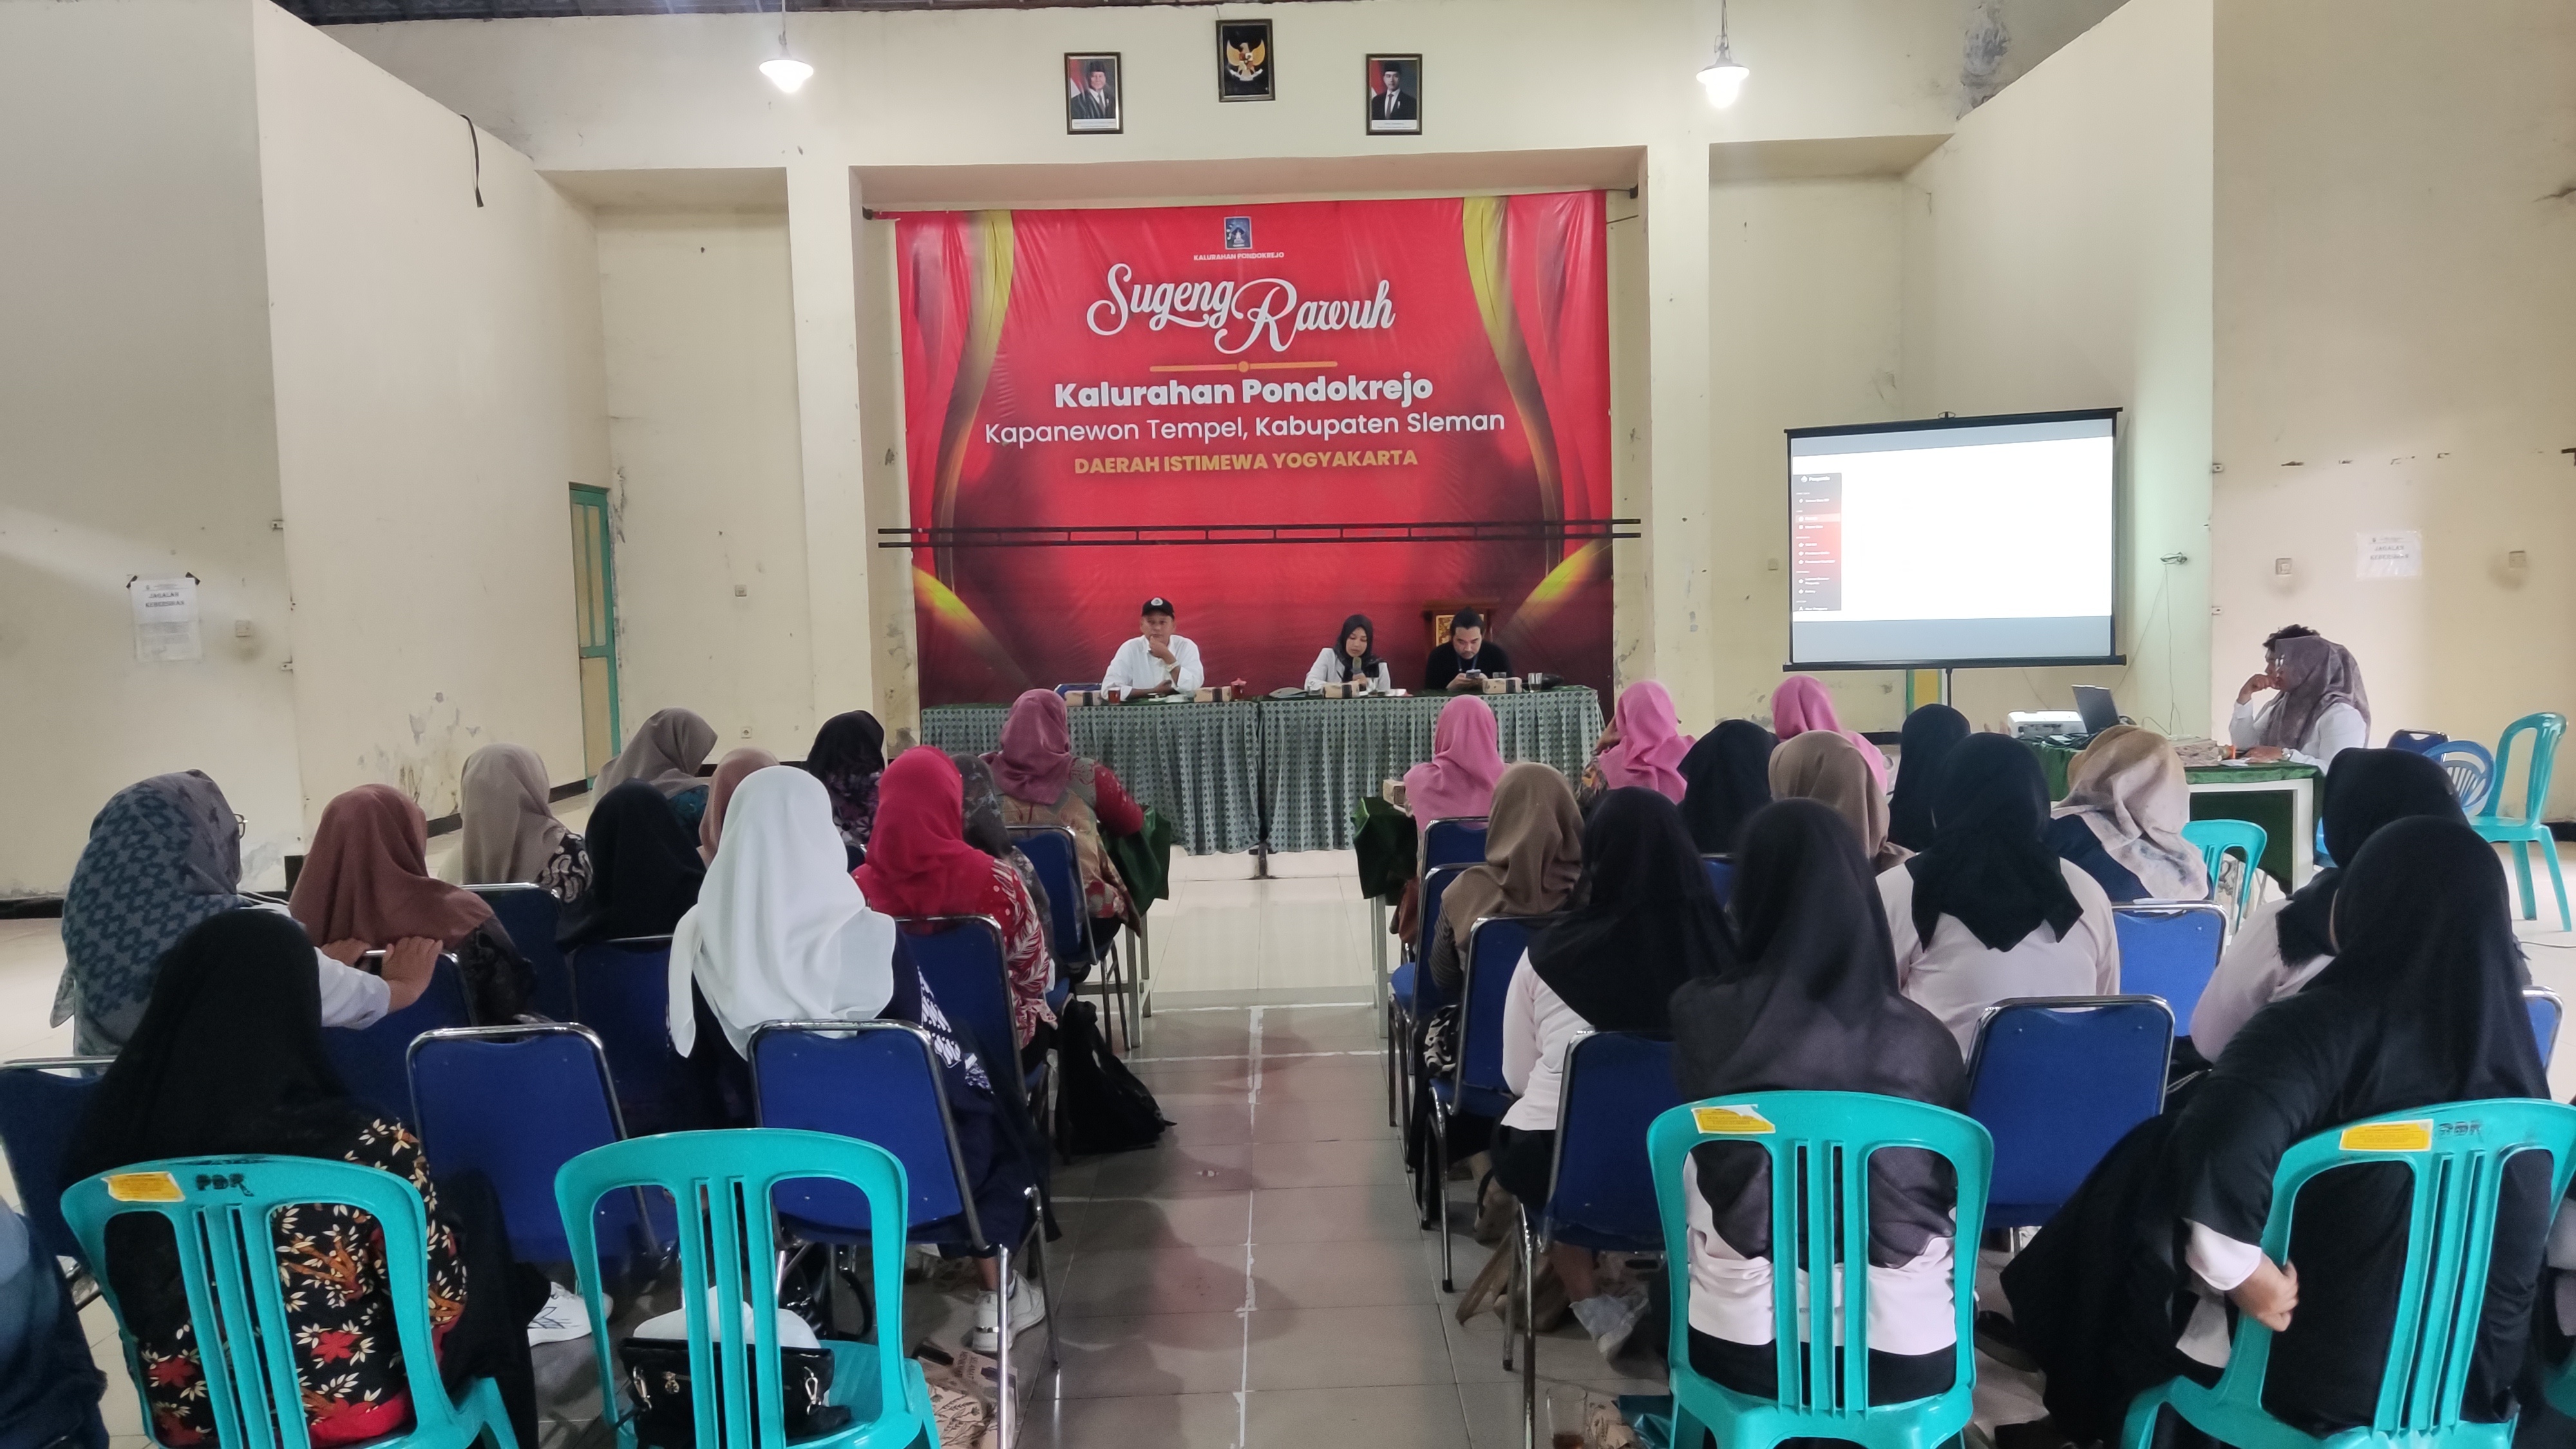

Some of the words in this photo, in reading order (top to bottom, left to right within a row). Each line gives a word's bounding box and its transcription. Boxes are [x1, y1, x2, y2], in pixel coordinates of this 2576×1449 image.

[1086, 263, 1235, 336] Sugeng
[1214, 278, 1396, 354] Rawuh
[1055, 379, 1235, 408] Kalurahan
[1242, 371, 1434, 408] Pondokrejo
[985, 424, 1139, 449] Kapanewon
[1146, 417, 1248, 444] Tempel,
[1256, 414, 1399, 441] Kabupaten
[1407, 412, 1504, 433] Sleman
[1074, 456, 1160, 474] DAERAH
[1164, 453, 1269, 472] ISTIMEWA
[1272, 450, 1418, 469] YOGYAKARTA
